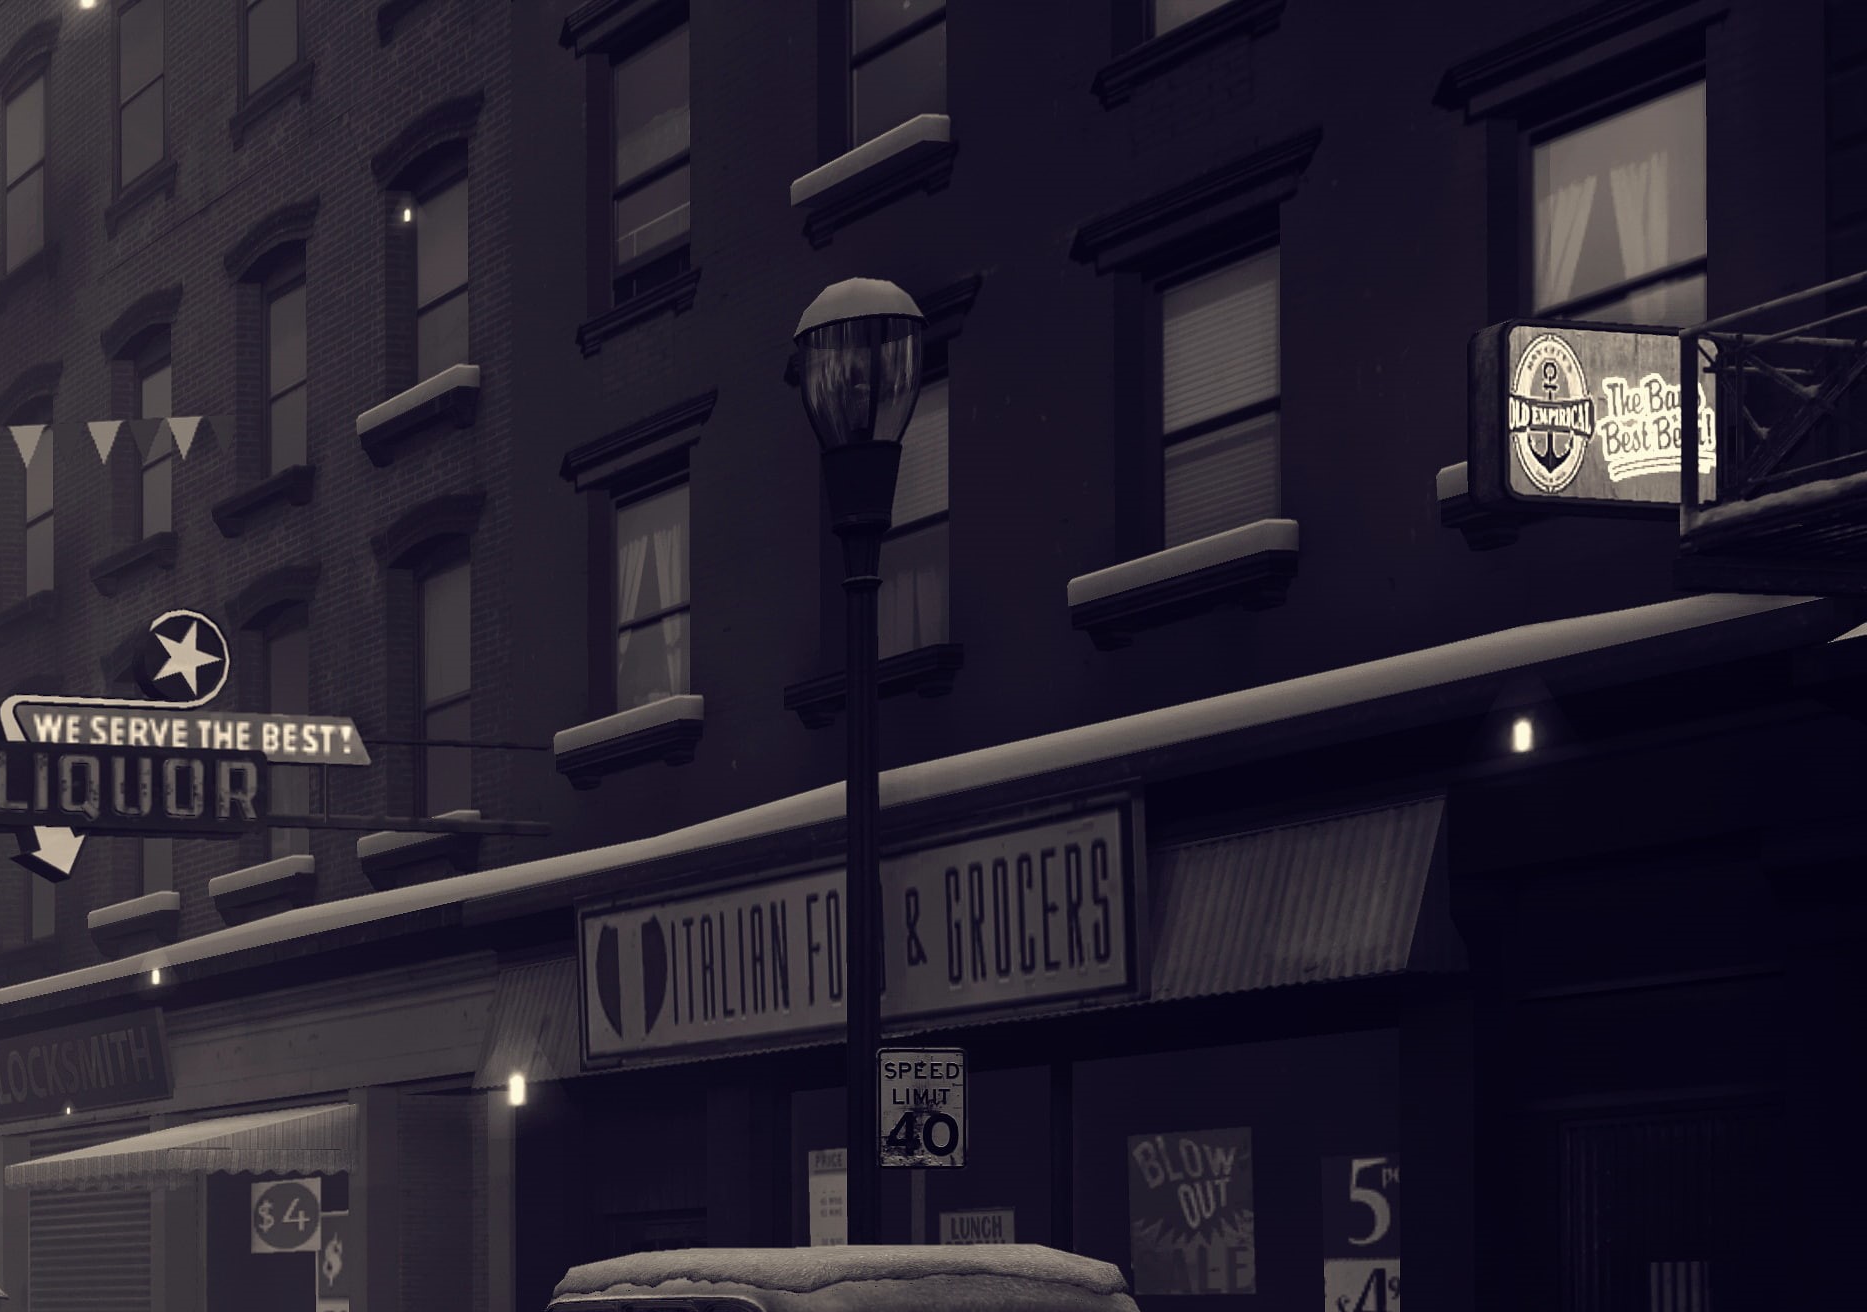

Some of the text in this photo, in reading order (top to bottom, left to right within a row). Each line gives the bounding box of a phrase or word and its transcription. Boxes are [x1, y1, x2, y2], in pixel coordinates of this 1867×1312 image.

[1509, 397, 1592, 435] OLD EMPIRICAL
[1607, 382, 1643, 417] The
[1601, 415, 1712, 455] Best Be!
[33, 713, 353, 755] WE SERVE THE BEST!
[671, 900, 790, 1027] ITALIAN
[905, 887, 928, 967] &
[945, 838, 1111, 986] GROCERS
[884, 1061, 960, 1080] SPEED
[892, 1087, 951, 1106] LIMIT
[886, 1110, 959, 1157] 40
[1132, 1134, 1239, 1190] BLOW
[258, 1198, 312, 1234] $4
[1177, 1178, 1233, 1229] OUT
[1348, 1157, 1392, 1246] 5
[950, 1215, 1003, 1241] LUNCH
